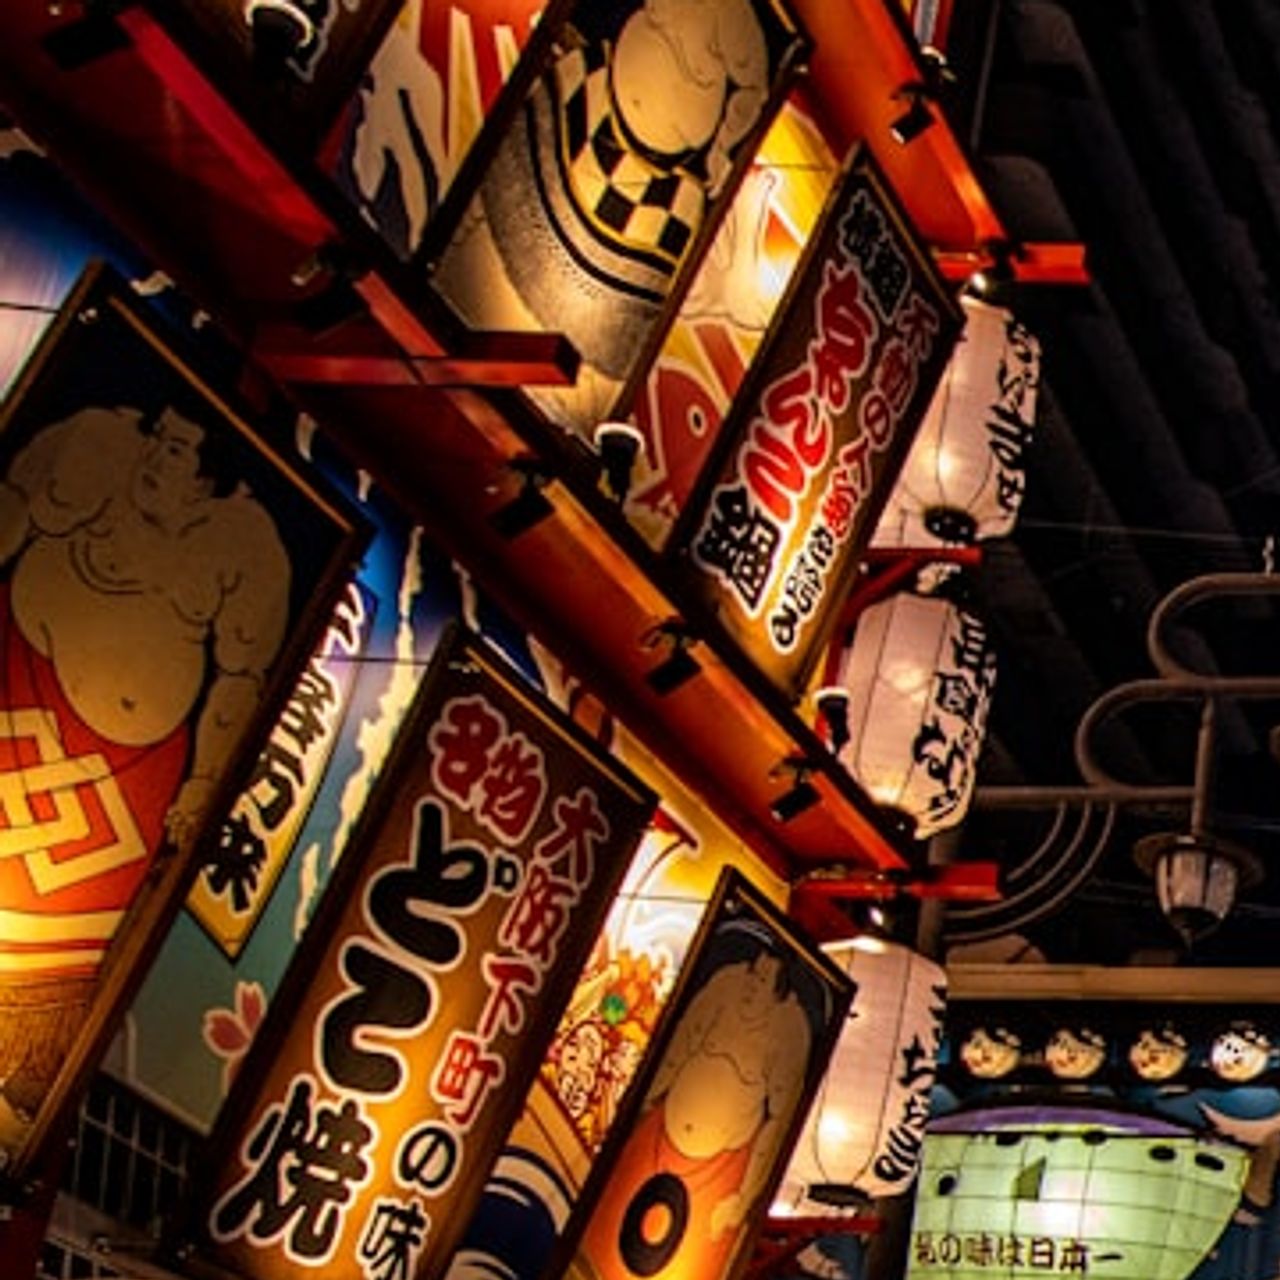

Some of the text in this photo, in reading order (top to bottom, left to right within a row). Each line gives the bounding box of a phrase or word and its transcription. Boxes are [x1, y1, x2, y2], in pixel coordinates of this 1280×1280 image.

[696, 262, 877, 616] ちゃんこ鍋
[430, 697, 544, 841] 名物
